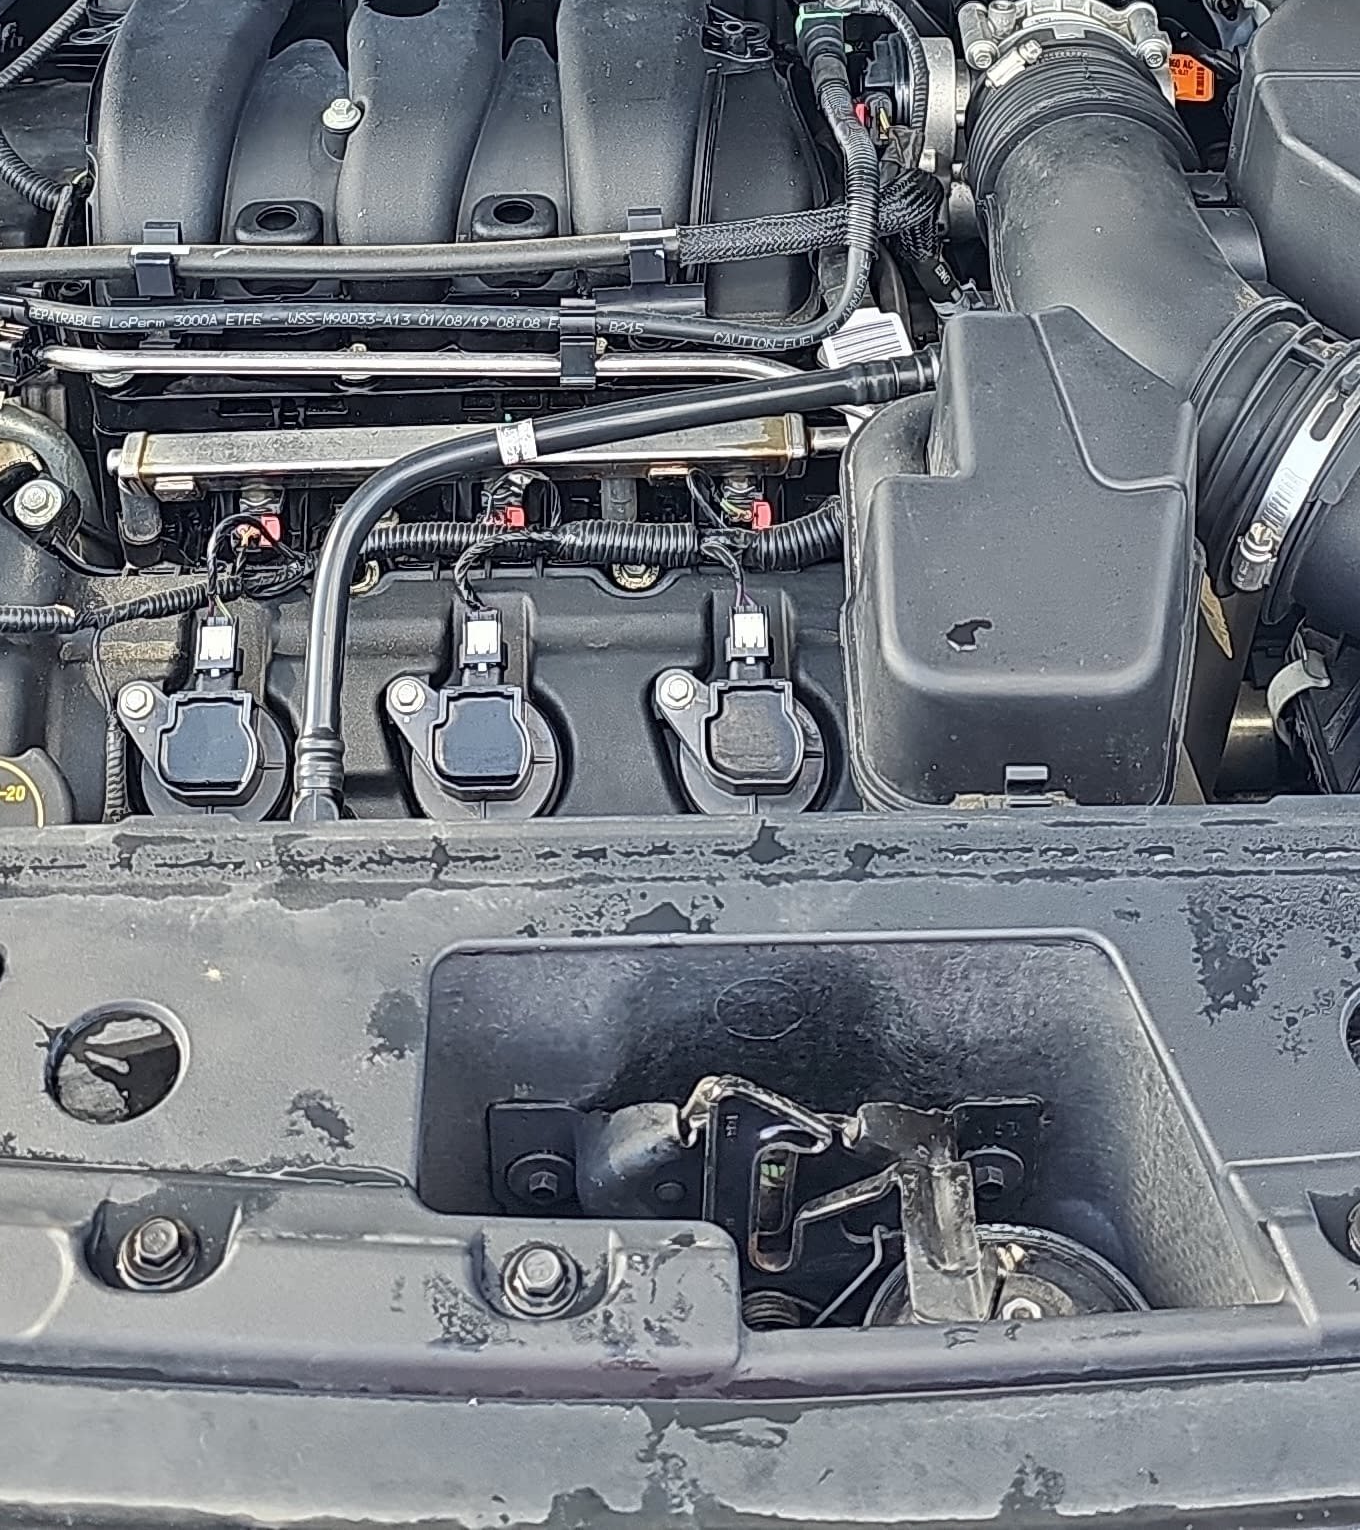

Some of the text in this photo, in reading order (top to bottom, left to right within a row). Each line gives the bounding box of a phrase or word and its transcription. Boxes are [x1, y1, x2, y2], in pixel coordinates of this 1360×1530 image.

[173, 314, 218, 327] 3000A
[226, 312, 264, 326] ETFE
[418, 313, 489, 328] 01/08/19
[496, 315, 541, 328] 08:08
[609, 321, 644, 334] B215
